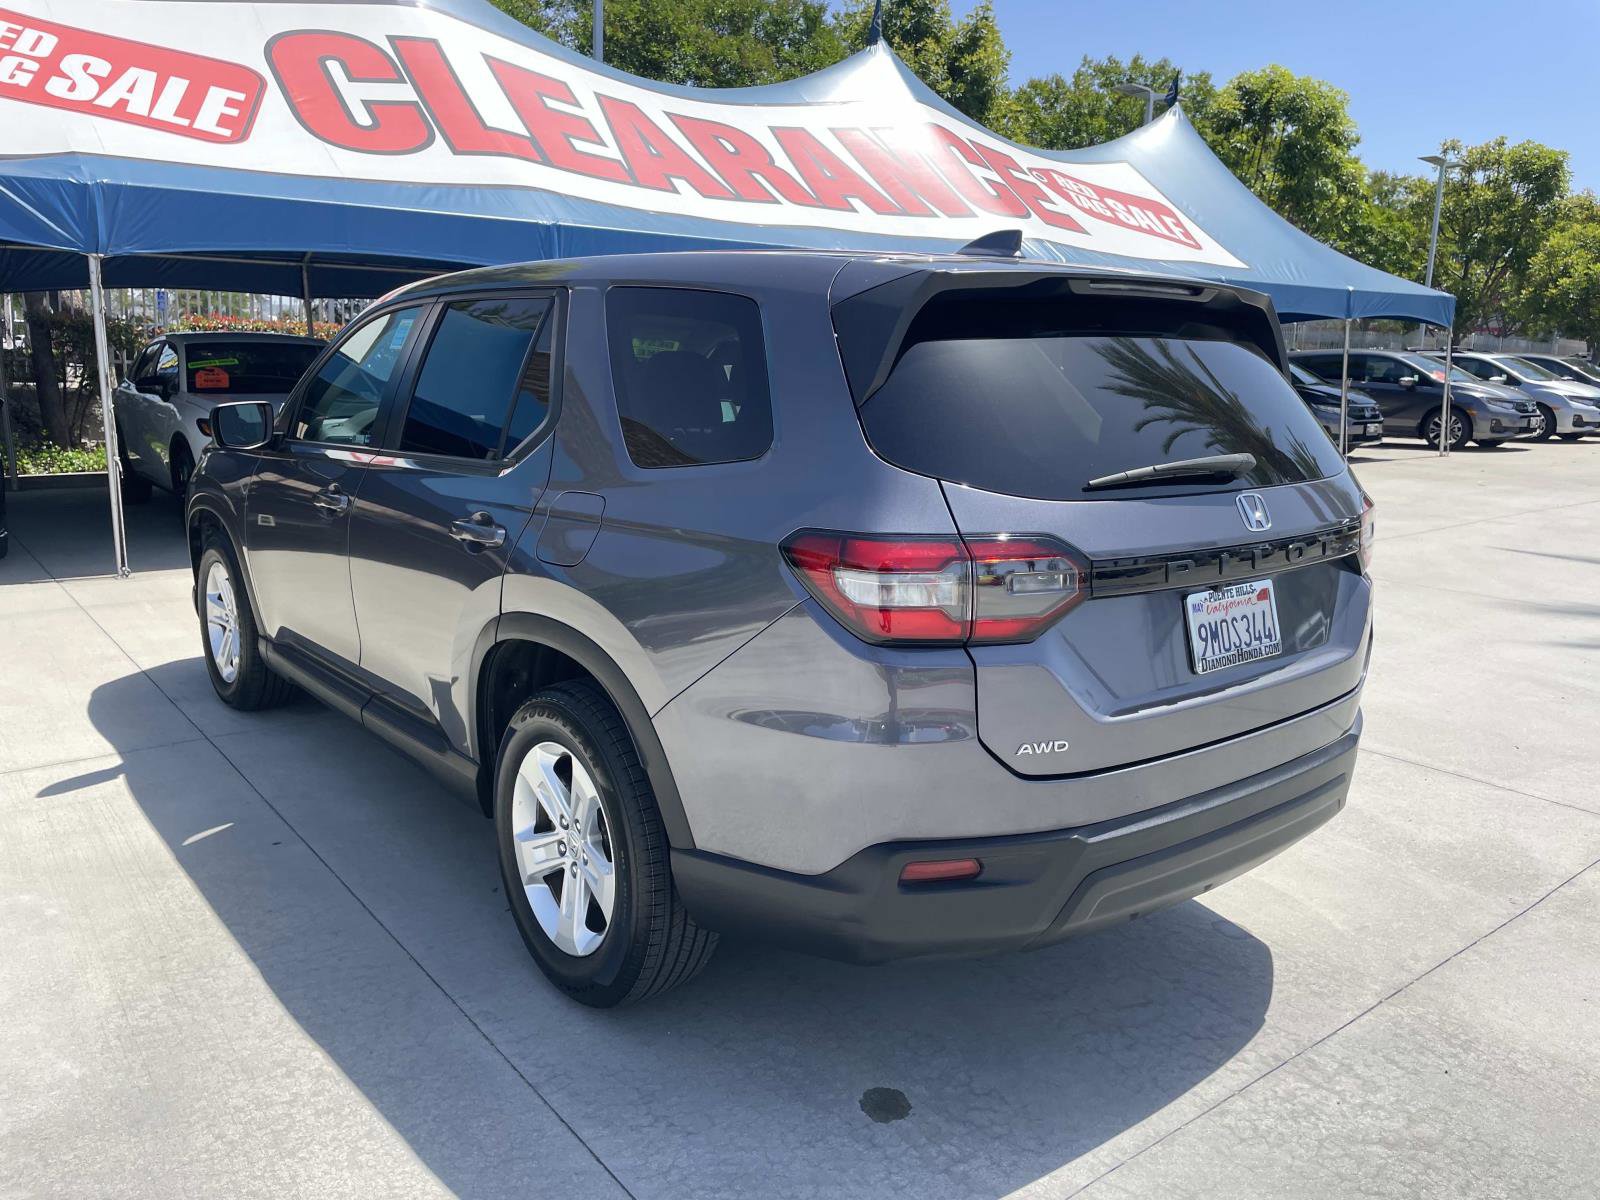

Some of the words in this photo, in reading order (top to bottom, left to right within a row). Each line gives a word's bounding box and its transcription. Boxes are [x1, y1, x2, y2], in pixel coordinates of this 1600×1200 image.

[45, 53, 247, 138] SALE
[263, 29, 1092, 235] CLEARANCE
[1049, 172, 1100, 200] RED
[1063, 188, 1115, 218] TAG
[1103, 197, 1196, 245] SALE
[1164, 535, 1335, 583] PILOT
[1206, 597, 1257, 616] California
[1197, 610, 1274, 657] 9MOS344
[1015, 740, 1069, 756] AWD
